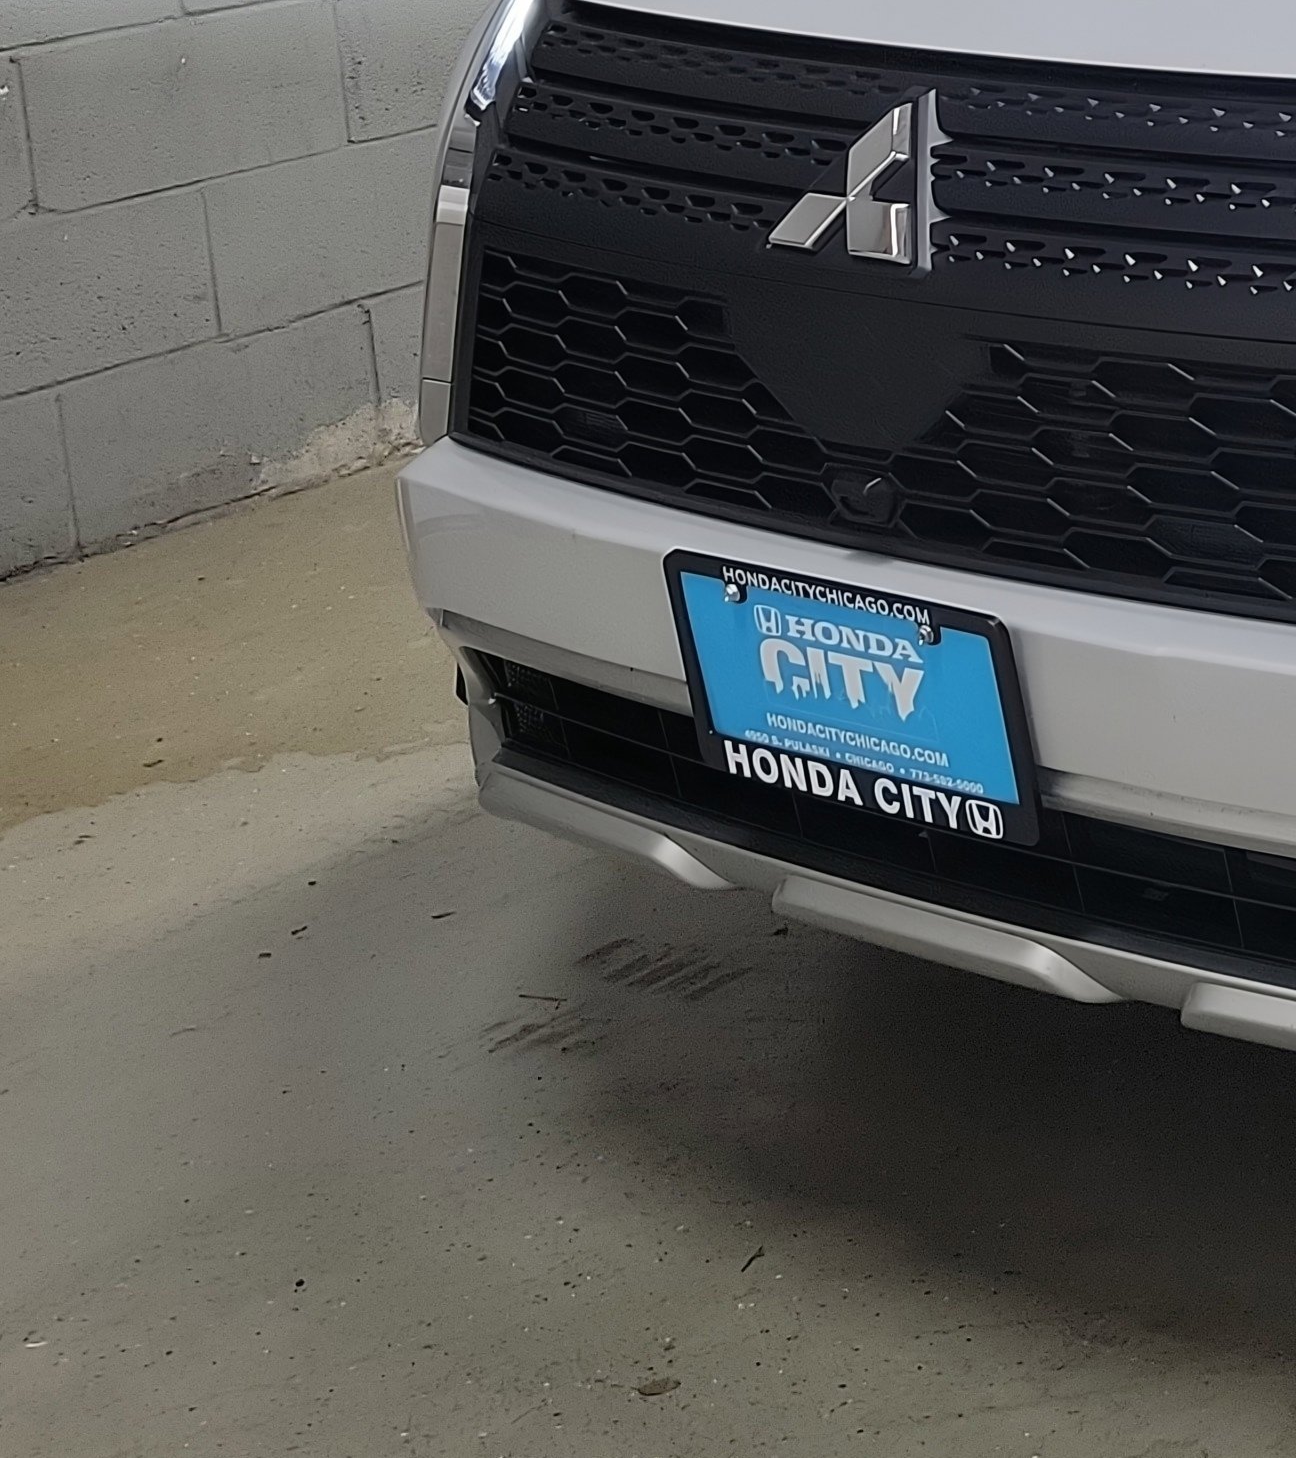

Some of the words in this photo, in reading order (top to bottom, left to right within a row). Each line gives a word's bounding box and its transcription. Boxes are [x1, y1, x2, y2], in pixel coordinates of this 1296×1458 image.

[722, 565, 931, 626] HONDACITYCHICAGO.COM
[786, 614, 925, 664] HONDA
[759, 637, 925, 722] CITY
[766, 713, 949, 768] HONDACITYCHICAGO.COM
[784, 737, 830, 758] PULASKI
[844, 752, 895, 774] CHICAGO
[723, 739, 864, 807] HONDA
[874, 777, 964, 831] CITY
